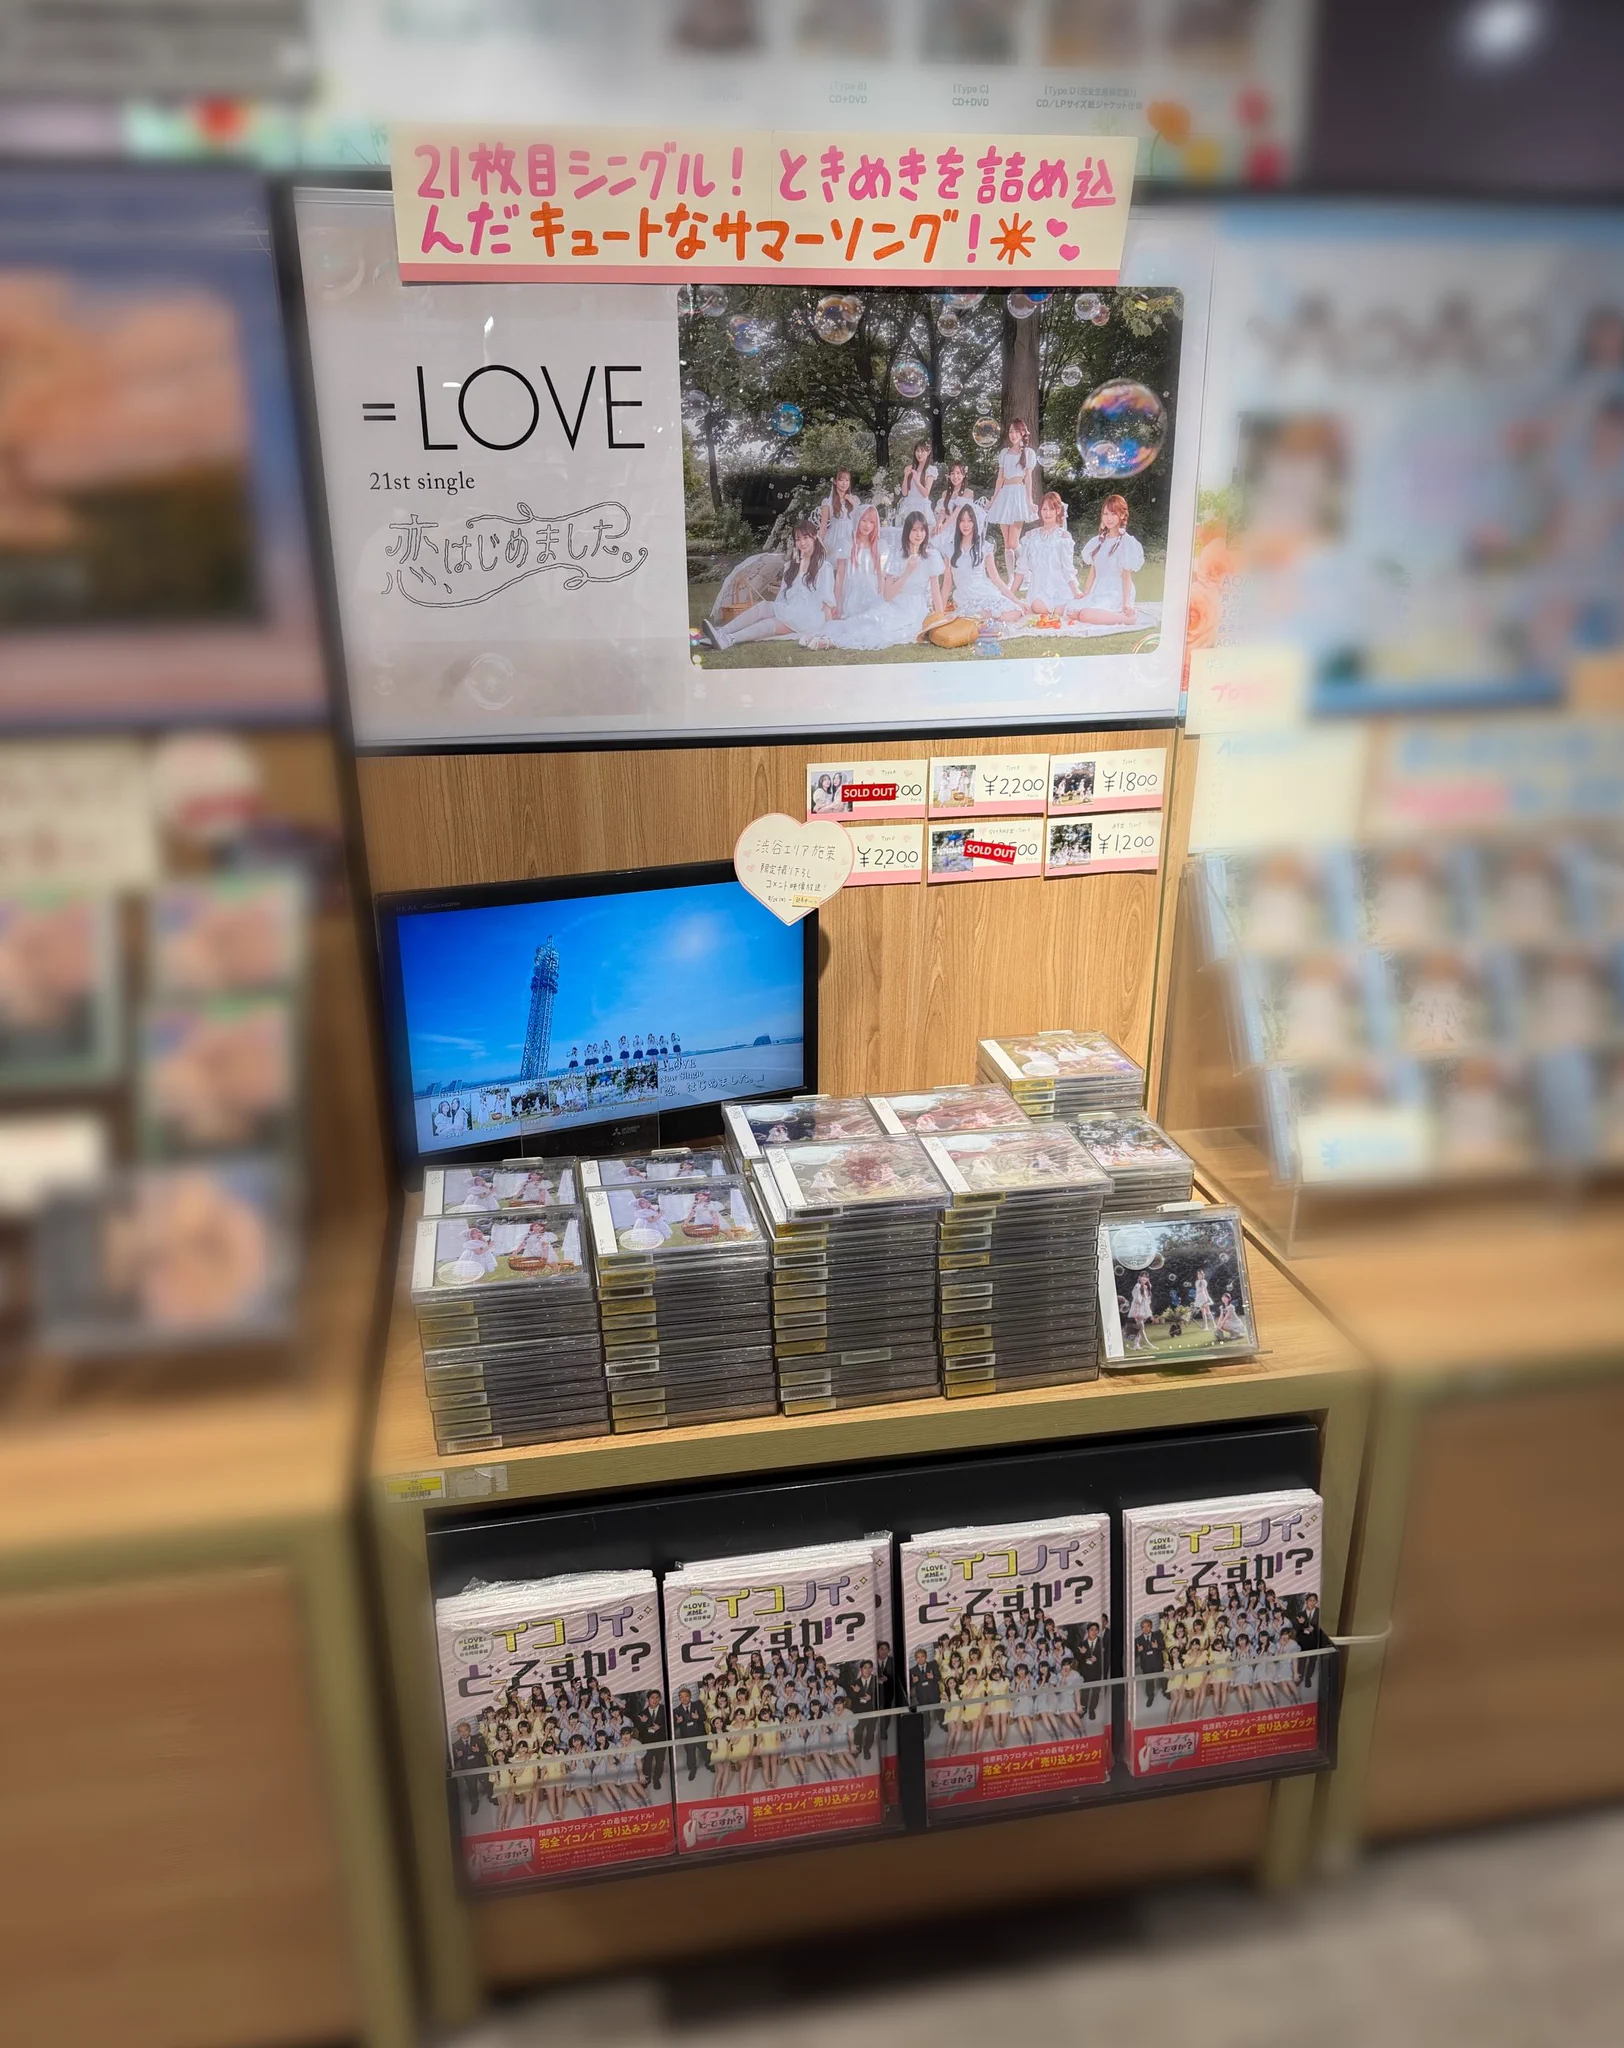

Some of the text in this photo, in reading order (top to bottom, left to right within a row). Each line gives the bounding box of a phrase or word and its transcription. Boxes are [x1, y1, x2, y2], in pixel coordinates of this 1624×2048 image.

[952, 97, 989, 107] CD+DVD
[779, 145, 1116, 209] ときめきを詰め込
[362, 364, 645, 450] =LOVE
[369, 471, 475, 495] 21st single
[844, 788, 870, 798] SOLD
[872, 787, 895, 797] OUT
[966, 844, 992, 856] SOLD
[993, 847, 1015, 859] OUT
